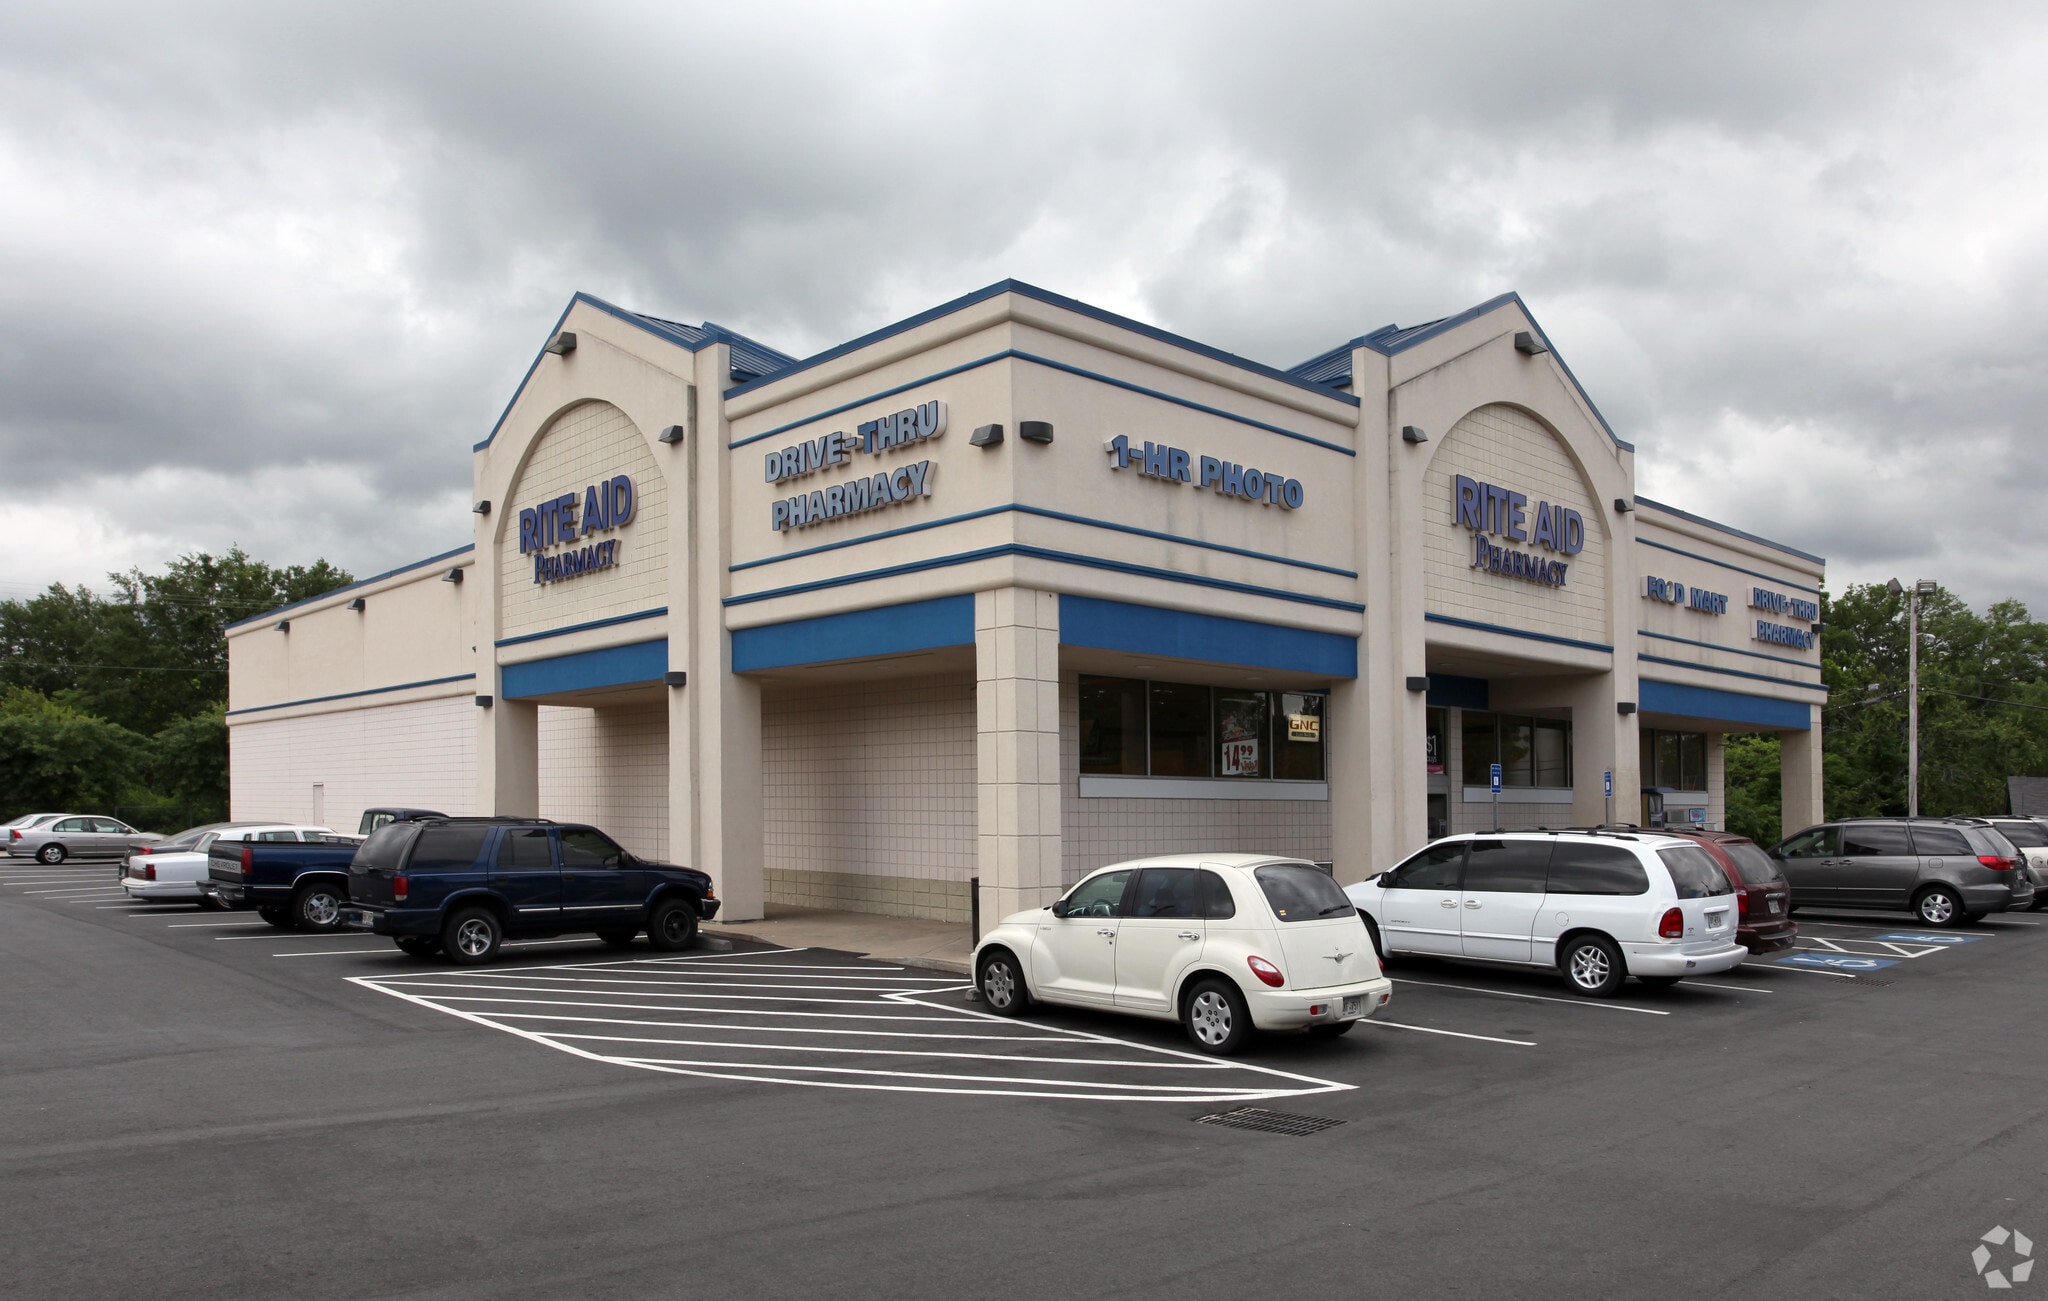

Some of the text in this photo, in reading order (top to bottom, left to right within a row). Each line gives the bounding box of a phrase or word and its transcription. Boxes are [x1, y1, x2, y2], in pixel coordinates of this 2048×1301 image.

[764, 399, 944, 484] DRIVE-THRU
[771, 459, 934, 532] PHARMACY
[1109, 434, 1305, 511] 1-HR PHOTO
[518, 473, 634, 555] RITE AID
[1454, 473, 1586, 556] RITE AID
[533, 537, 619, 585] PHARMACY
[1473, 533, 1569, 587] PHARMACY
[1646, 574, 1729, 615] FOOD MART
[1751, 586, 1819, 622] DRIVE-THRU
[1755, 619, 1817, 650] PHARMACY
[1289, 718, 1319, 731] GNC
[210, 859, 239, 870] CHEVROLET
